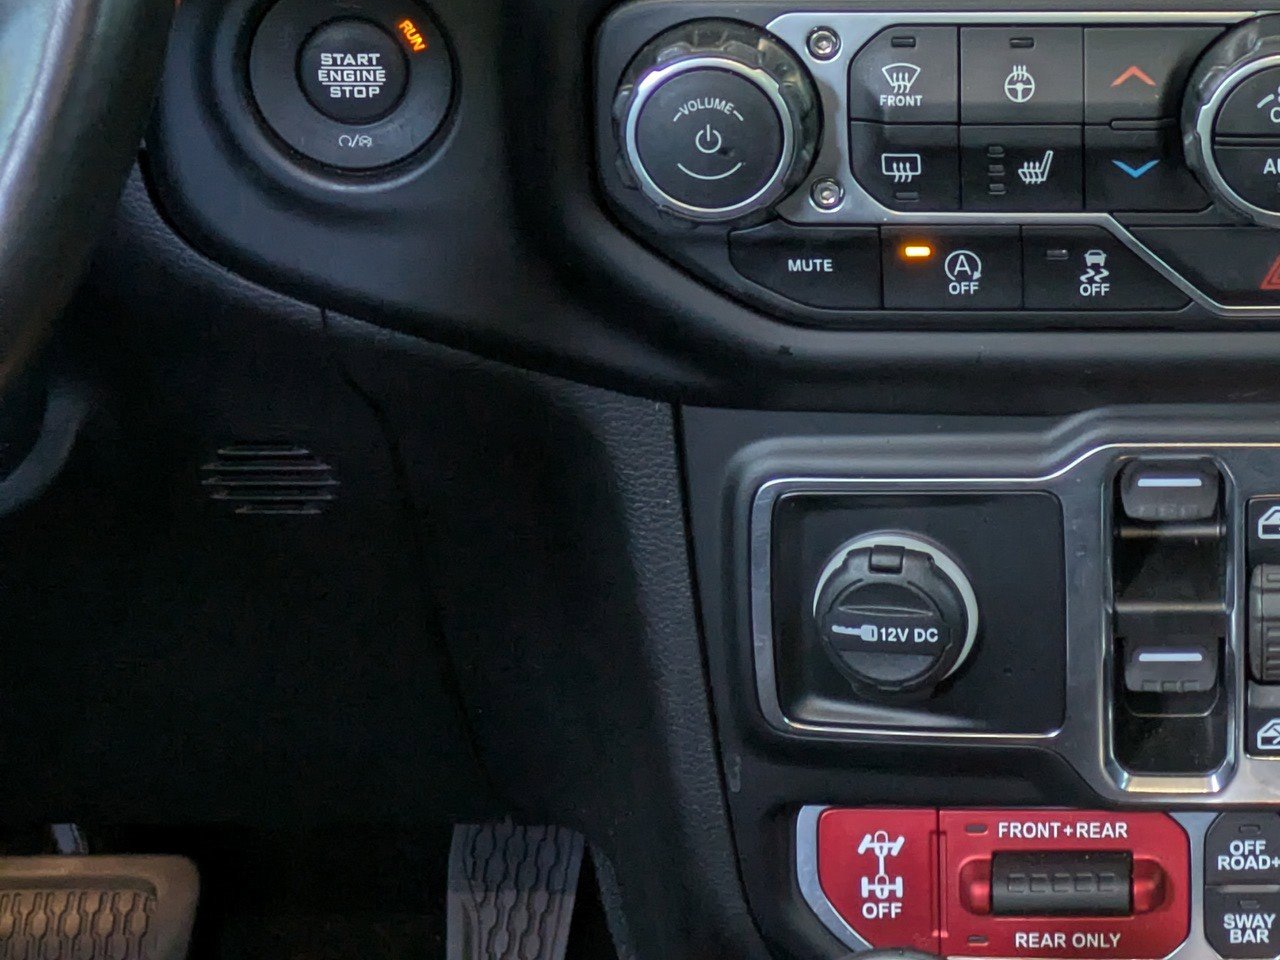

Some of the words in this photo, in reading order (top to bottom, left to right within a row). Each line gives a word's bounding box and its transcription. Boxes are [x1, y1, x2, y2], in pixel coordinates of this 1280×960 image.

[399, 19, 427, 52] RUN
[320, 53, 381, 66] START
[318, 70, 386, 82] ENGINE
[330, 86, 380, 99] STOP
[679, 98, 735, 116] VOLUME
[879, 95, 923, 107] FRONT
[787, 259, 833, 273] MUTE
[948, 281, 980, 296] OFF
[1079, 282, 1110, 297] OFF
[879, 627, 909, 642] 12V
[914, 627, 939, 643] DC
[1230, 840, 1266, 855] OFF
[1217, 854, 1280, 871] ROAD+
[862, 902, 902, 919] OFF
[1223, 913, 1276, 930] SWAY
[1015, 932, 1068, 948] REAR
[1073, 932, 1121, 948] ONLY
[1230, 927, 1269, 944] BAR
